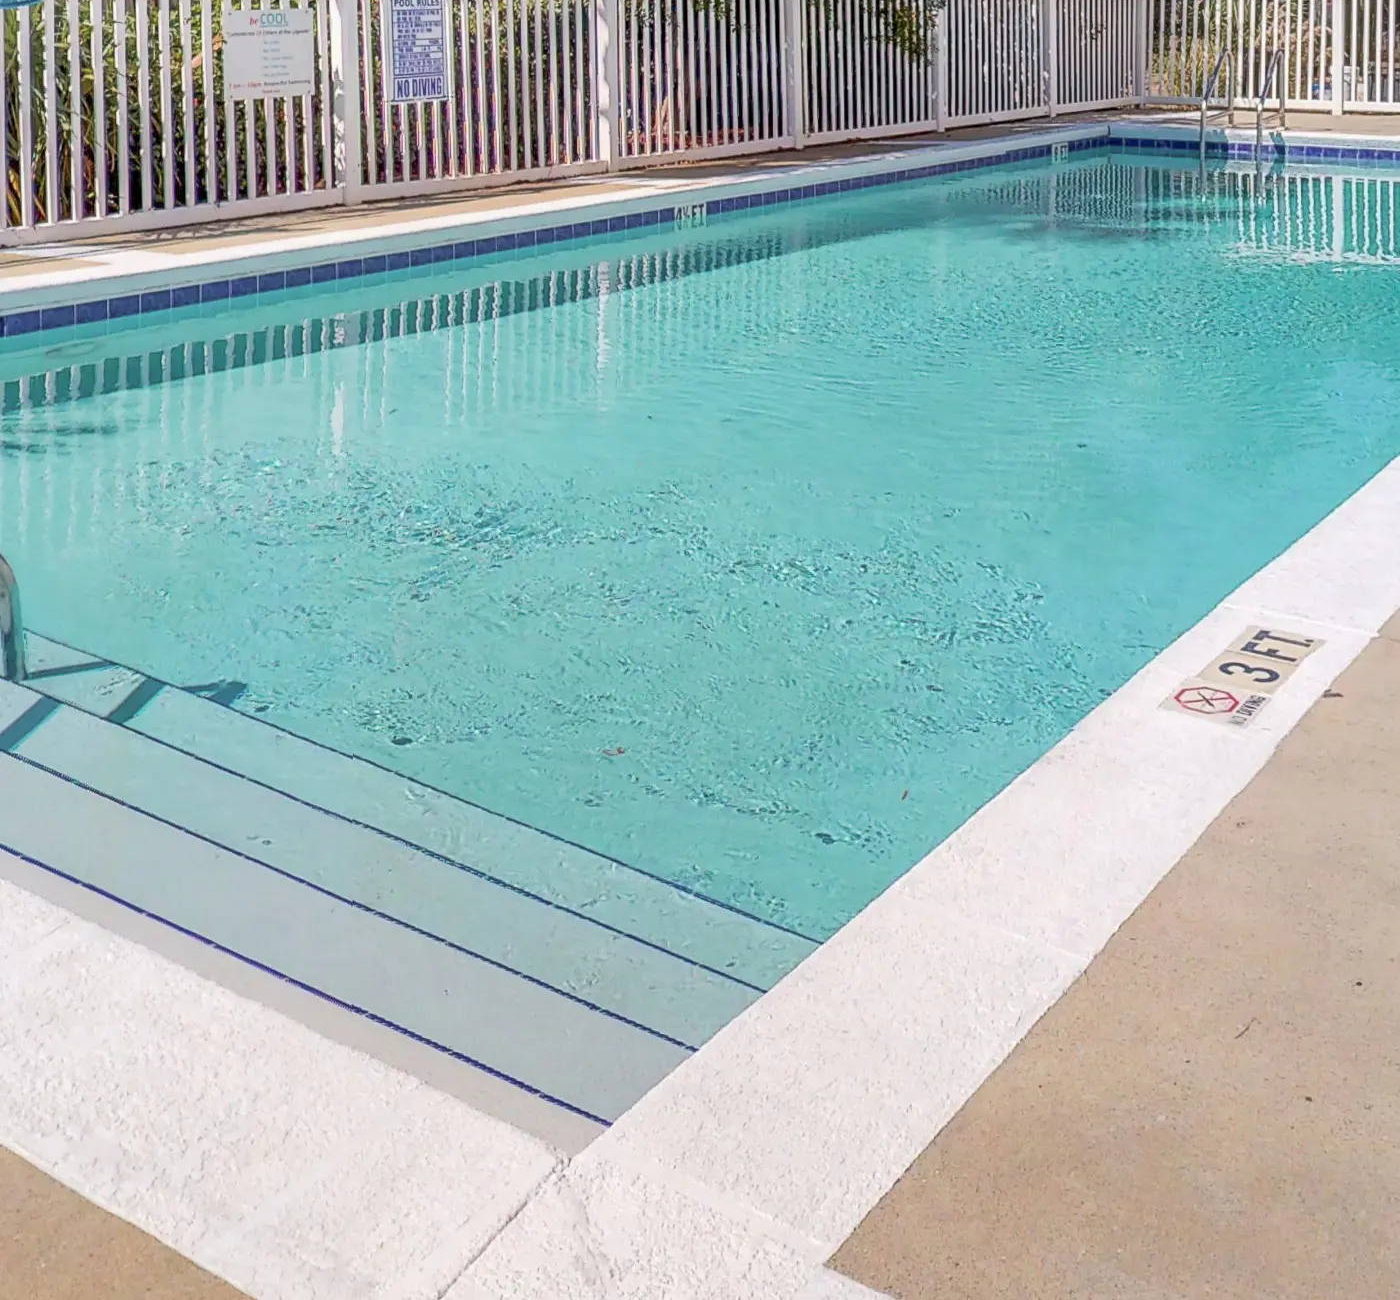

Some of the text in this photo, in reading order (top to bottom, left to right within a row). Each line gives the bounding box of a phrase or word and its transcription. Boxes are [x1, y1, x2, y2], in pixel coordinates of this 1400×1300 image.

[260, 12, 289, 26] COOL
[397, 76, 442, 99] NO DIVING
[1219, 661, 1280, 683] 3
